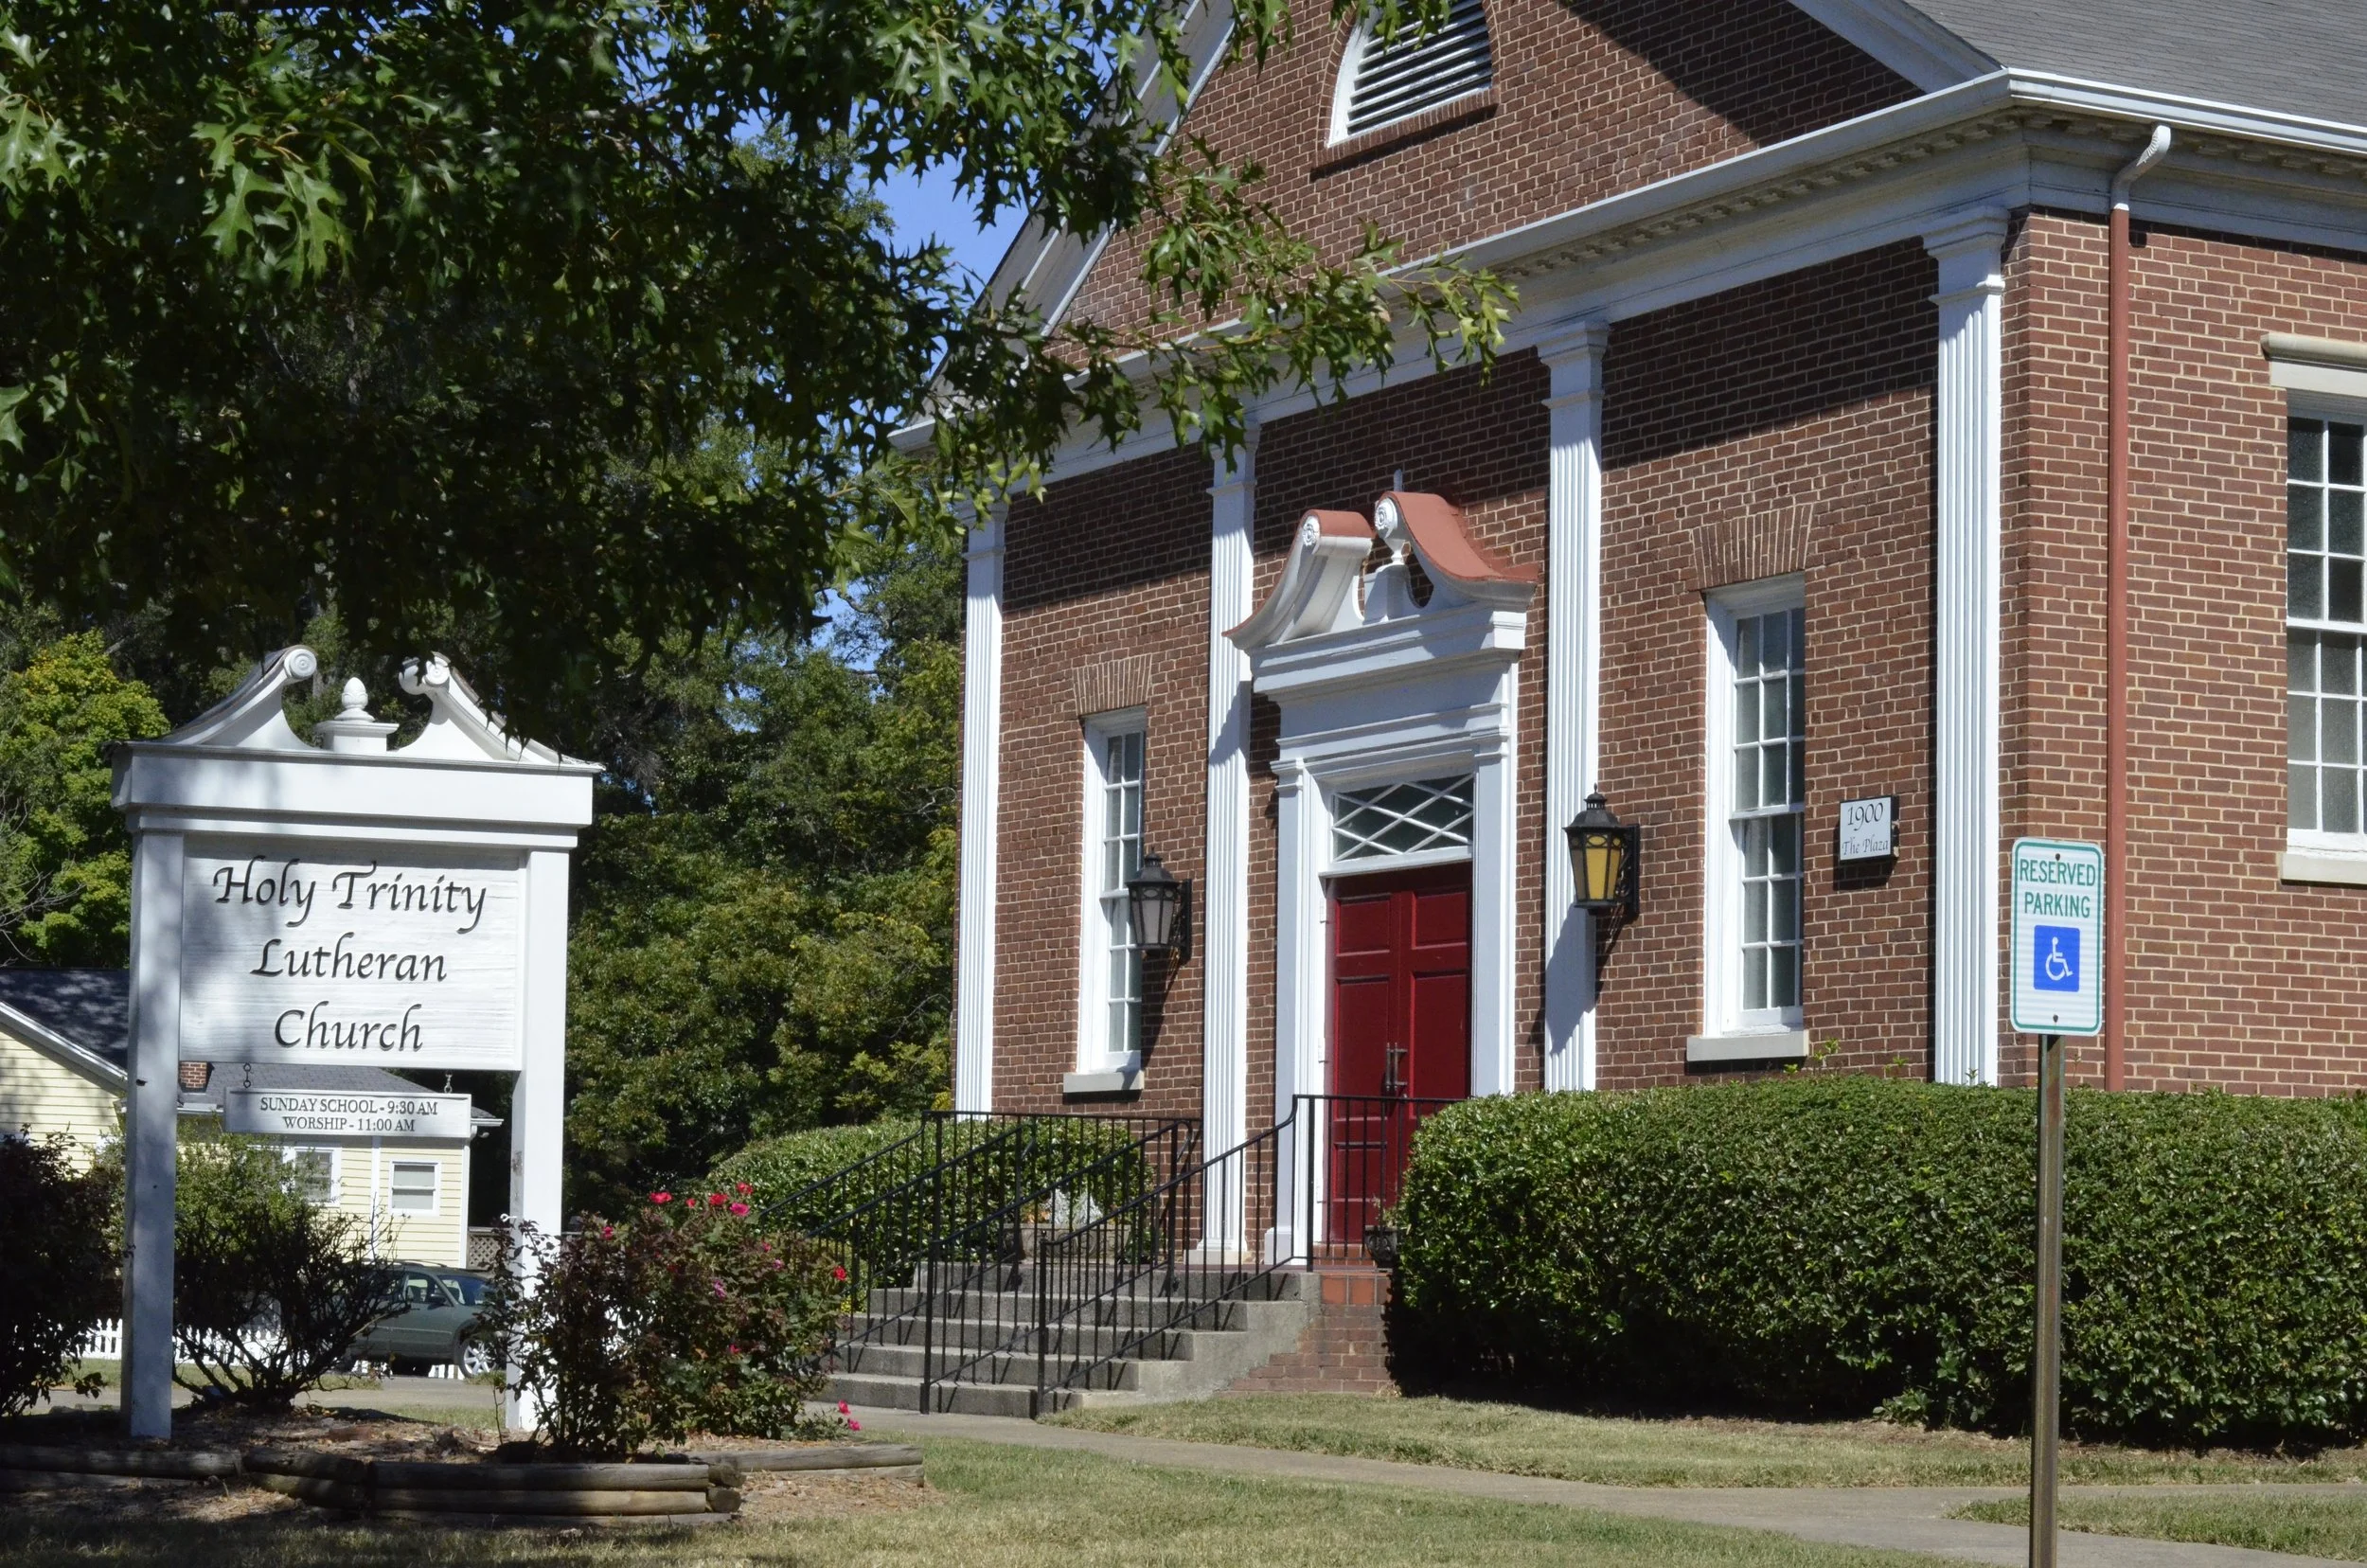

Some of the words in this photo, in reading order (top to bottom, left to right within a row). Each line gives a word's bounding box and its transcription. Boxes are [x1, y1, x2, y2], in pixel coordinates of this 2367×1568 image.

[1847, 802, 1884, 831] 1900
[1842, 836, 1860, 856] The
[1862, 833, 1889, 853] Plaza
[2020, 858, 2096, 886] RESERVED
[212, 855, 317, 928] Holy
[331, 860, 487, 935] Trinity
[2024, 891, 2091, 918] PARKING
[250, 932, 448, 982] Lutheran
[274, 1000, 423, 1052] Church
[259, 1096, 317, 1112] SUNDAY
[319, 1098, 378, 1114] SCHOOL
[387, 1100, 415, 1114] 9:30
[417, 1101, 438, 1115] AM
[283, 1115, 347, 1131] WORSHIP
[357, 1118, 392, 1131] 11:00
[394, 1119, 416, 1132] AM
